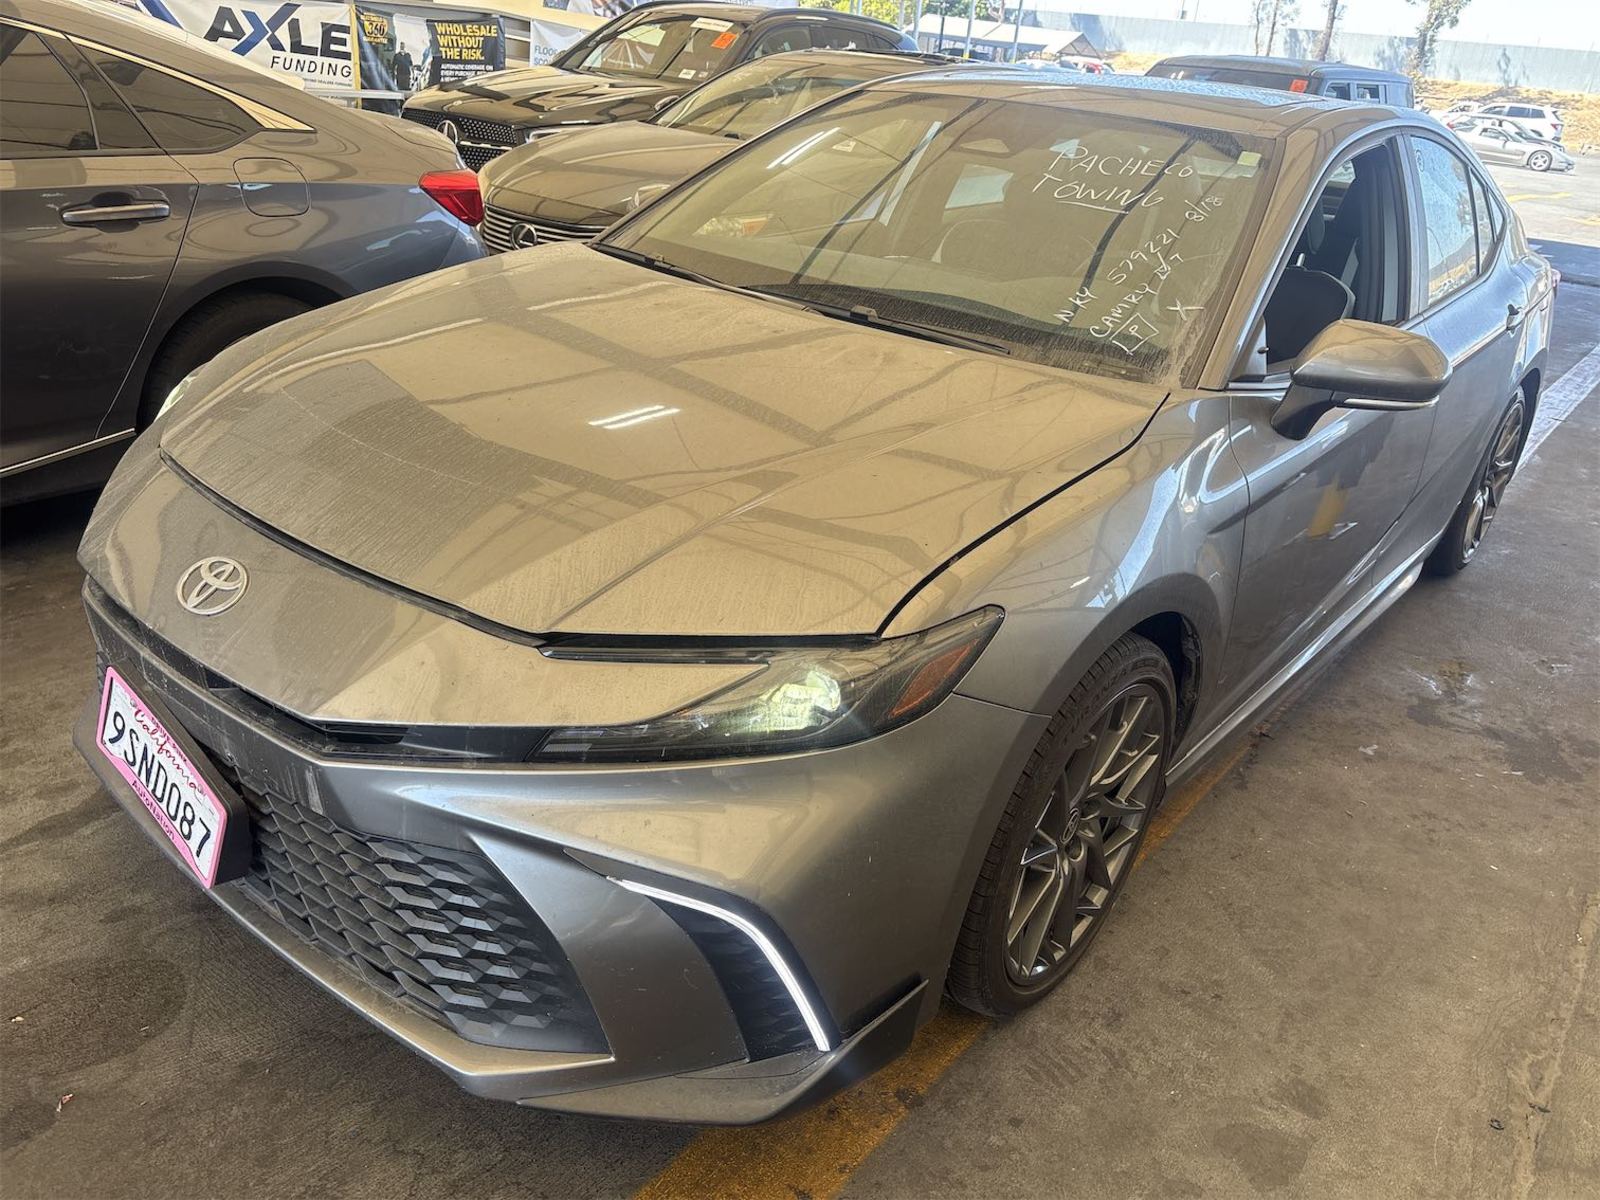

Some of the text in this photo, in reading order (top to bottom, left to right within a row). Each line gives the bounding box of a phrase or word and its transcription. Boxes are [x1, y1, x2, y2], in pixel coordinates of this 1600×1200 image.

[203, 2, 352, 61] AXLE
[367, 21, 385, 36] 360
[434, 22, 498, 37] WHOLESALE
[437, 34, 484, 48] WITHOUT
[270, 55, 352, 78] FUNDING
[439, 47, 485, 60] THE RISK.
[1048, 146, 1194, 178] PACHECO
[1032, 173, 1164, 208] TOWING
[1089, 282, 1159, 338] CAMRY
[134, 709, 199, 789] California
[108, 710, 212, 858] 9SND087
[131, 779, 176, 843] AutoNation
